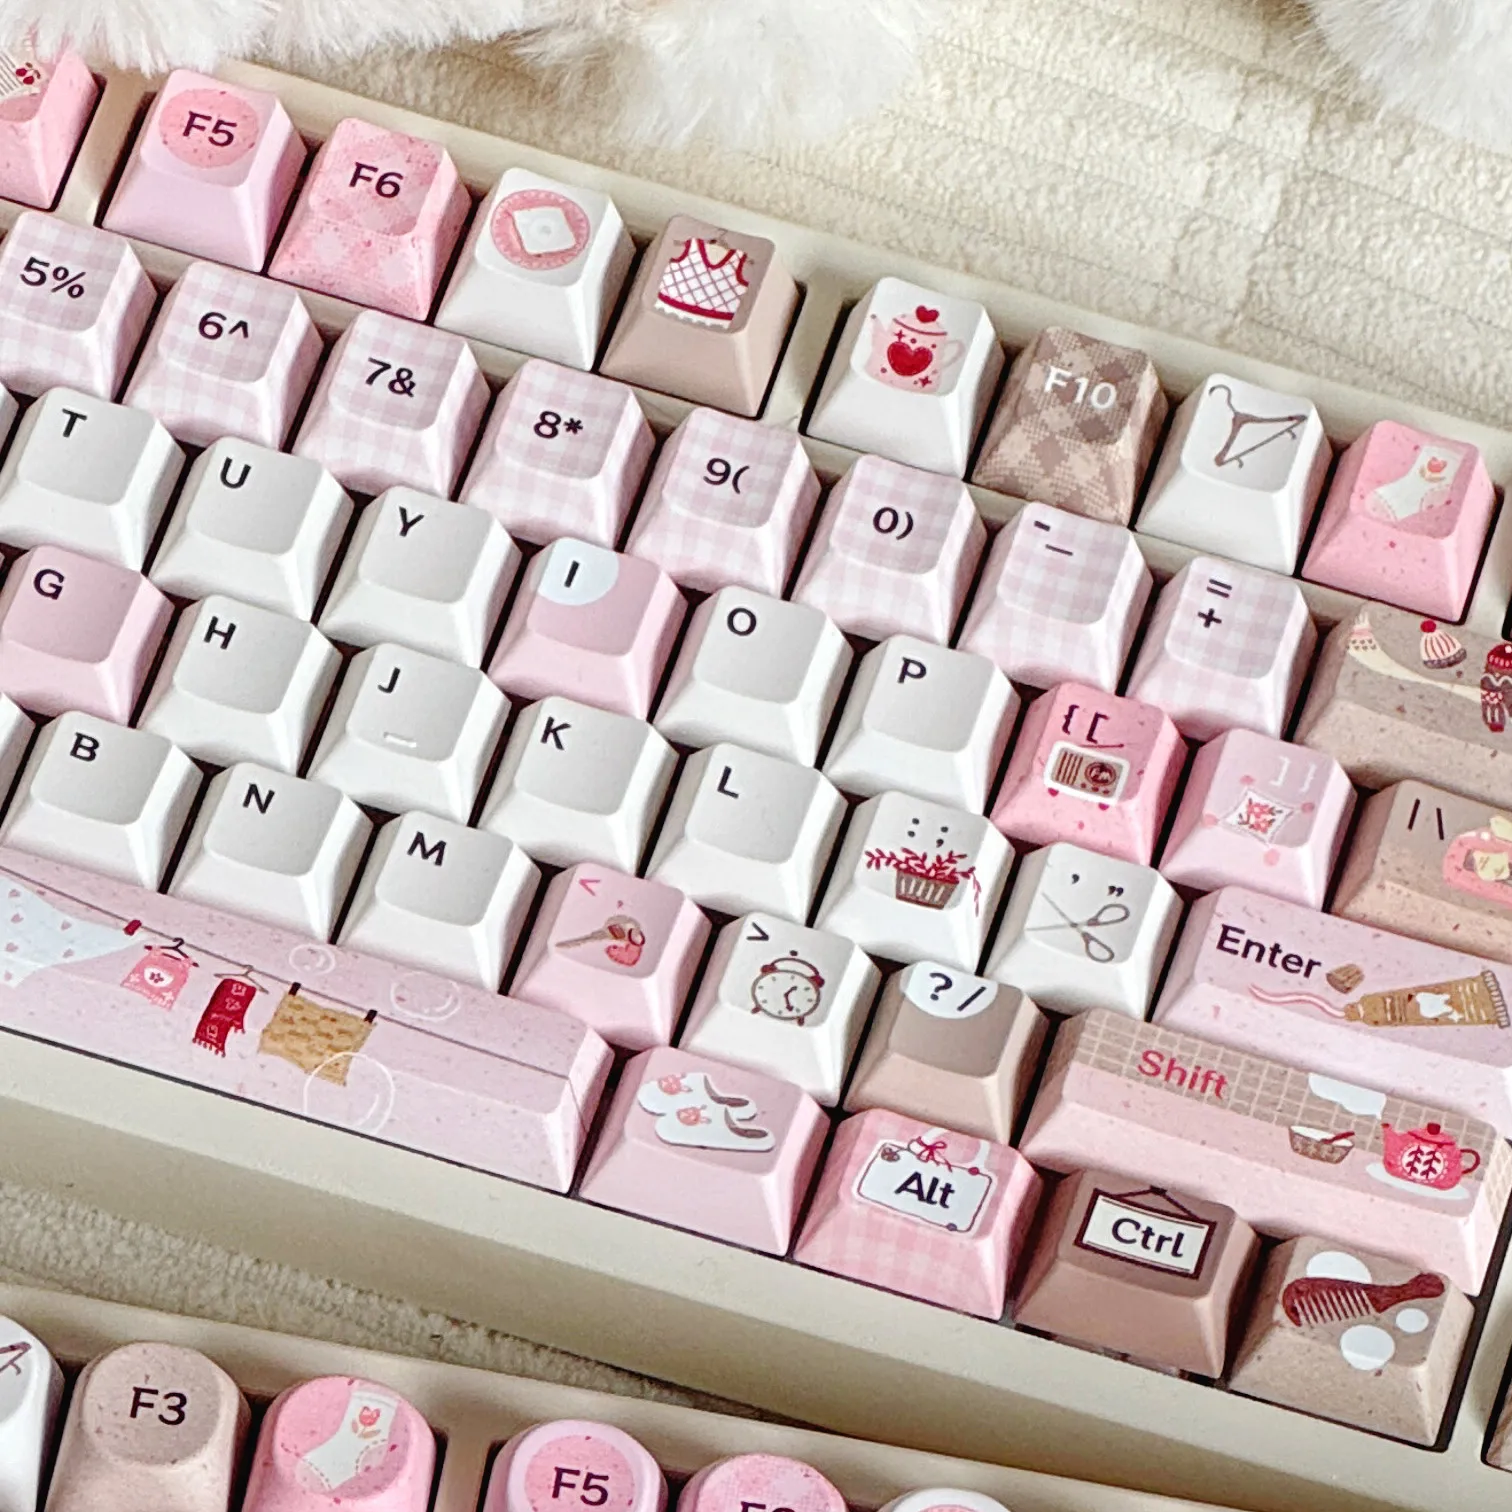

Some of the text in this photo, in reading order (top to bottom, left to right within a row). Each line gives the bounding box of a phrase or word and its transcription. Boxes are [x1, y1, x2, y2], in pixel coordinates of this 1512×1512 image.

[182, 111, 237, 147] F5
[349, 162, 404, 199] F6
[20, 257, 85, 299] 5%
[365, 358, 416, 398] 7&
[1045, 367, 1117, 410] F10
[61, 409, 87, 438] T
[219, 458, 251, 489] U
[703, 457, 750, 495] 9(
[397, 507, 424, 538] Y
[33, 568, 64, 599] G
[203, 616, 236, 650] H
[377, 668, 401, 694] J
[897, 657, 927, 684] P
[69, 732, 100, 762] B
[541, 717, 572, 750] K
[242, 782, 275, 814] N
[717, 766, 740, 798] L
[407, 831, 447, 867] M
[1215, 923, 1322, 980] Enter
[1136, 1050, 1229, 1098] Shift
[895, 1172, 955, 1209] Alt
[1111, 1217, 1186, 1258] Ctrl
[129, 1386, 188, 1425] F3
[551, 1467, 610, 1506] F5
